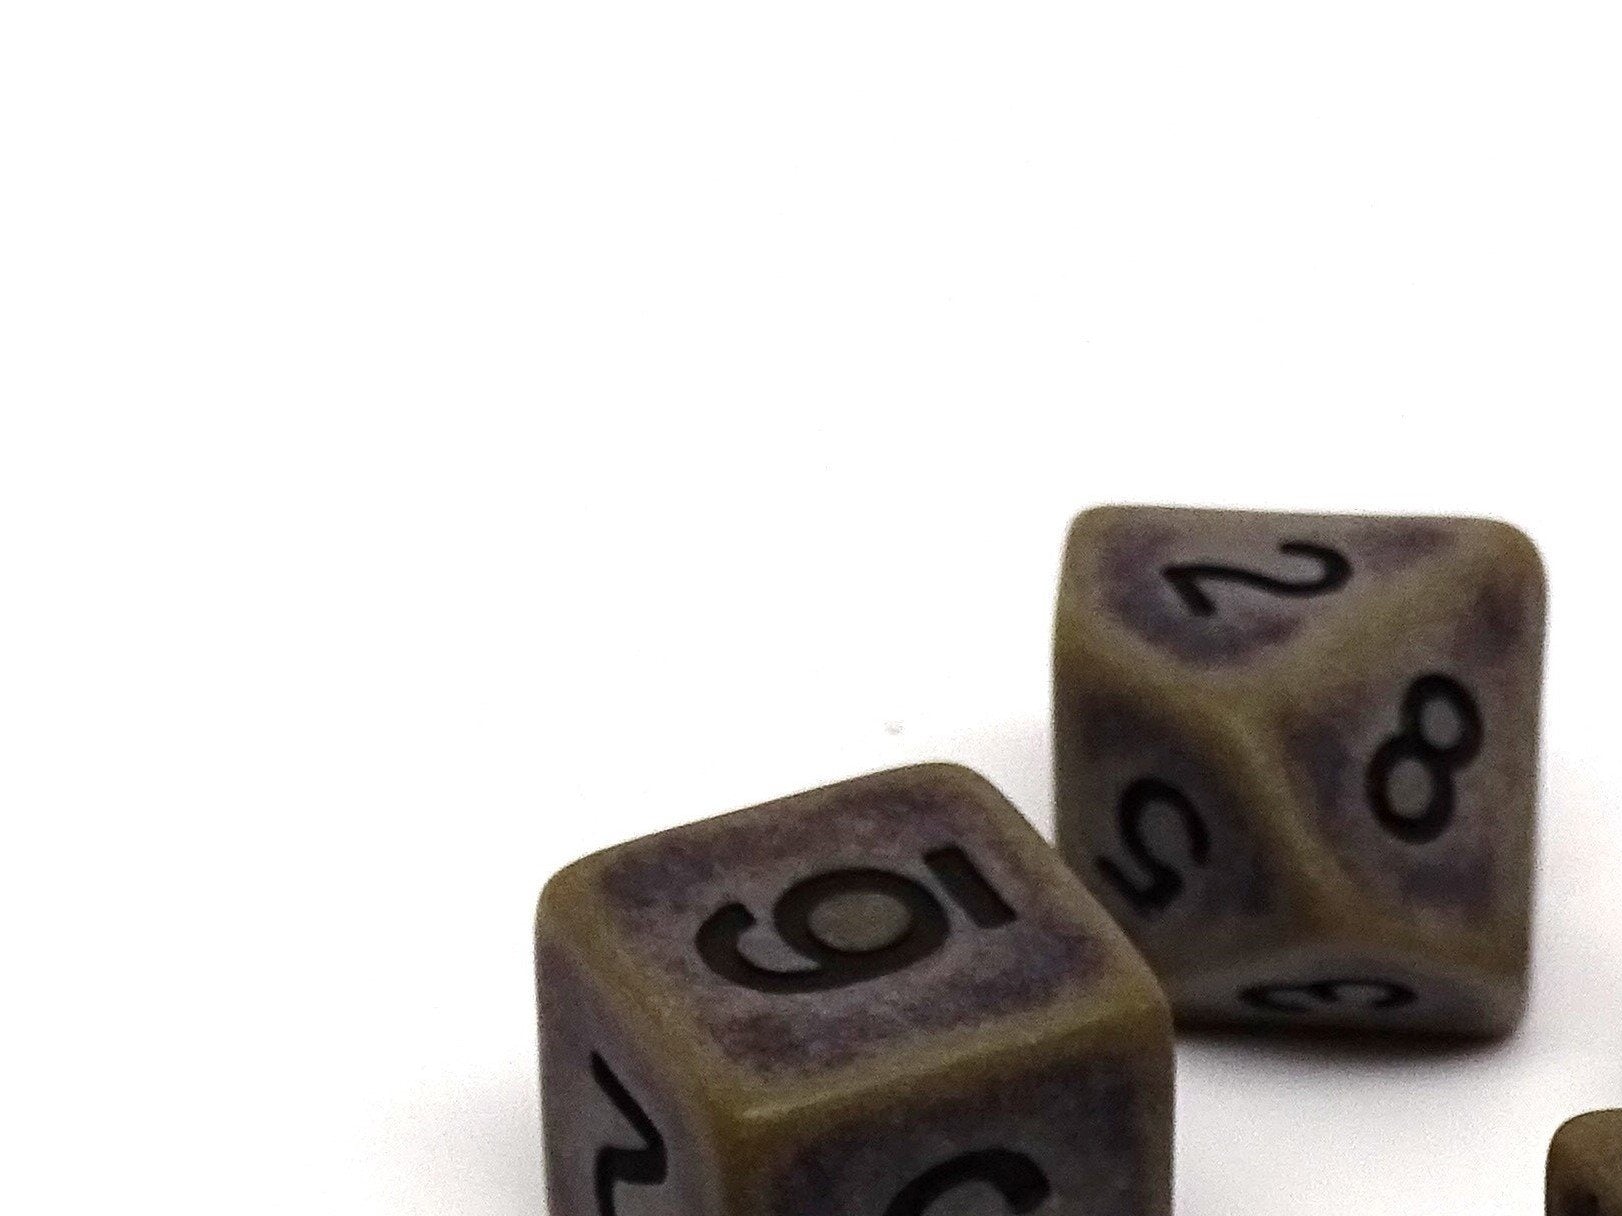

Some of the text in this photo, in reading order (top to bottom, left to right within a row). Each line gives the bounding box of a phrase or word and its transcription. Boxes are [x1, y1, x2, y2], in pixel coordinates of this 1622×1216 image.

[1161, 539, 1353, 618] 2
[1365, 673, 1484, 844] 8
[1096, 775, 1211, 913] 5
[694, 845, 1017, 996] 6
